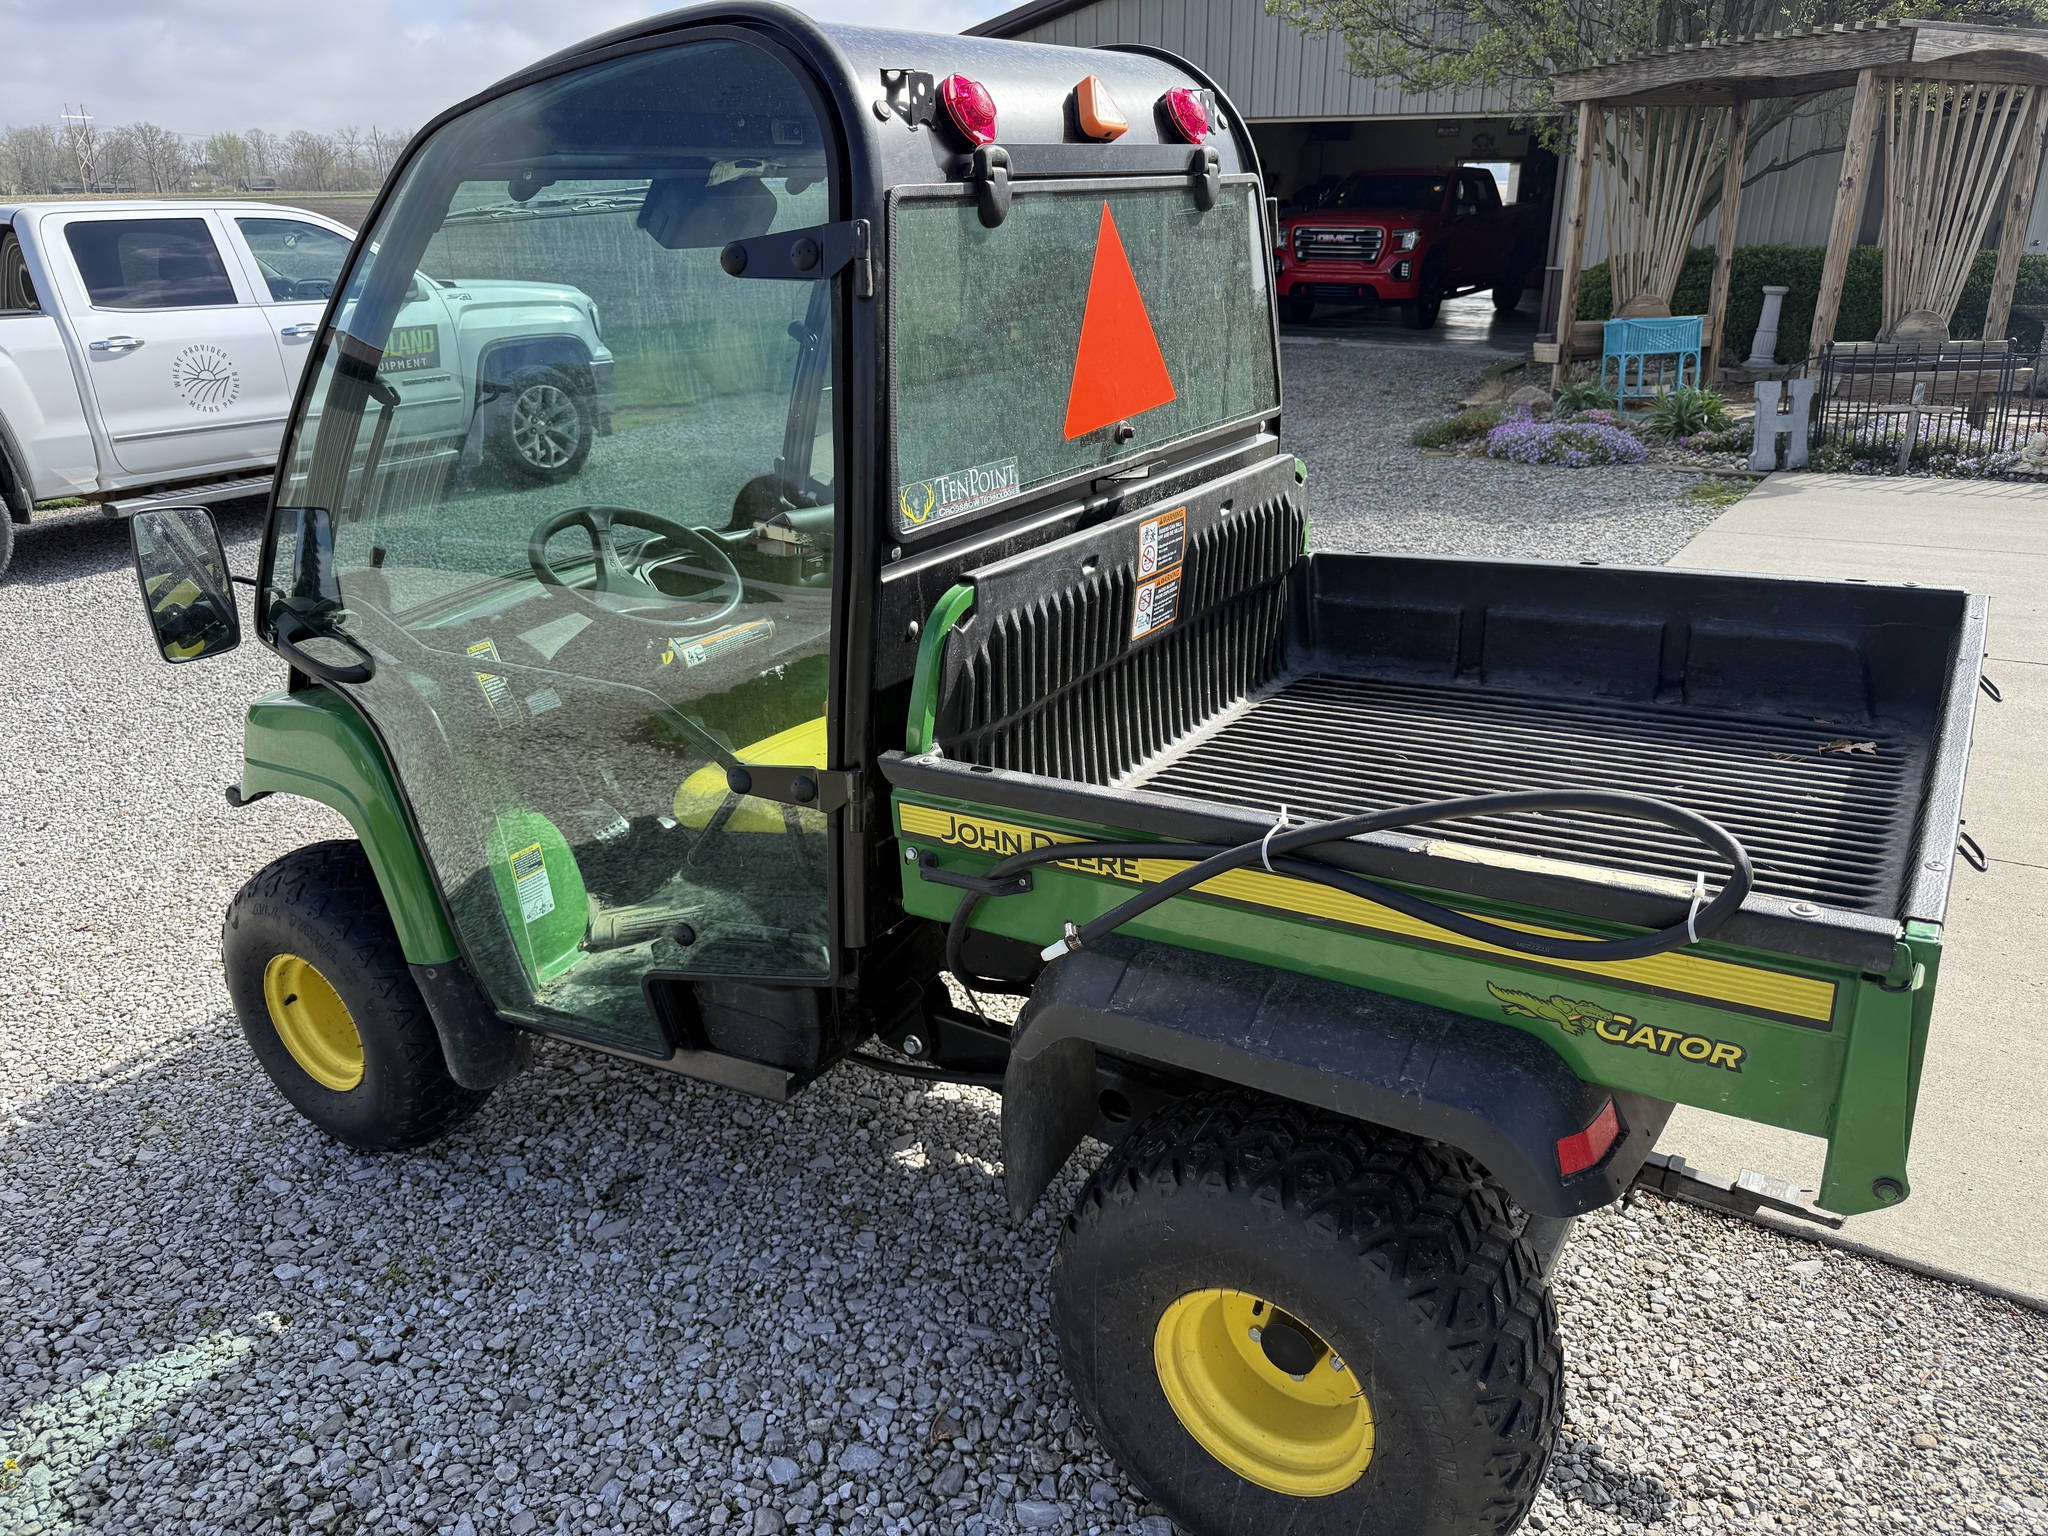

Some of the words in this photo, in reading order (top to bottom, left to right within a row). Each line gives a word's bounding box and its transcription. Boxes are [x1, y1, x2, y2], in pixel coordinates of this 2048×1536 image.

[1317, 234, 1354, 243] GMC
[383, 329, 435, 358] LAND
[172, 356, 183, 388] WHERE
[182, 344, 227, 360] PROVIDER
[379, 357, 427, 372] UIPMENT
[188, 400, 220, 413] MEANS
[222, 371, 240, 409] PARTNER
[1748, 378, 1814, 471] H
[938, 498, 980, 517] CROSSBOW
[980, 486, 1020, 505] TECHNOLOGIES
[1163, 508, 1184, 523] WARNING
[1160, 569, 1180, 585] WARNING
[941, 816, 1023, 854] JOHN
[252, 903, 281, 920] ALL
[289, 912, 338, 965] TRAIL
[1594, 1013, 1746, 1072] GATOR
